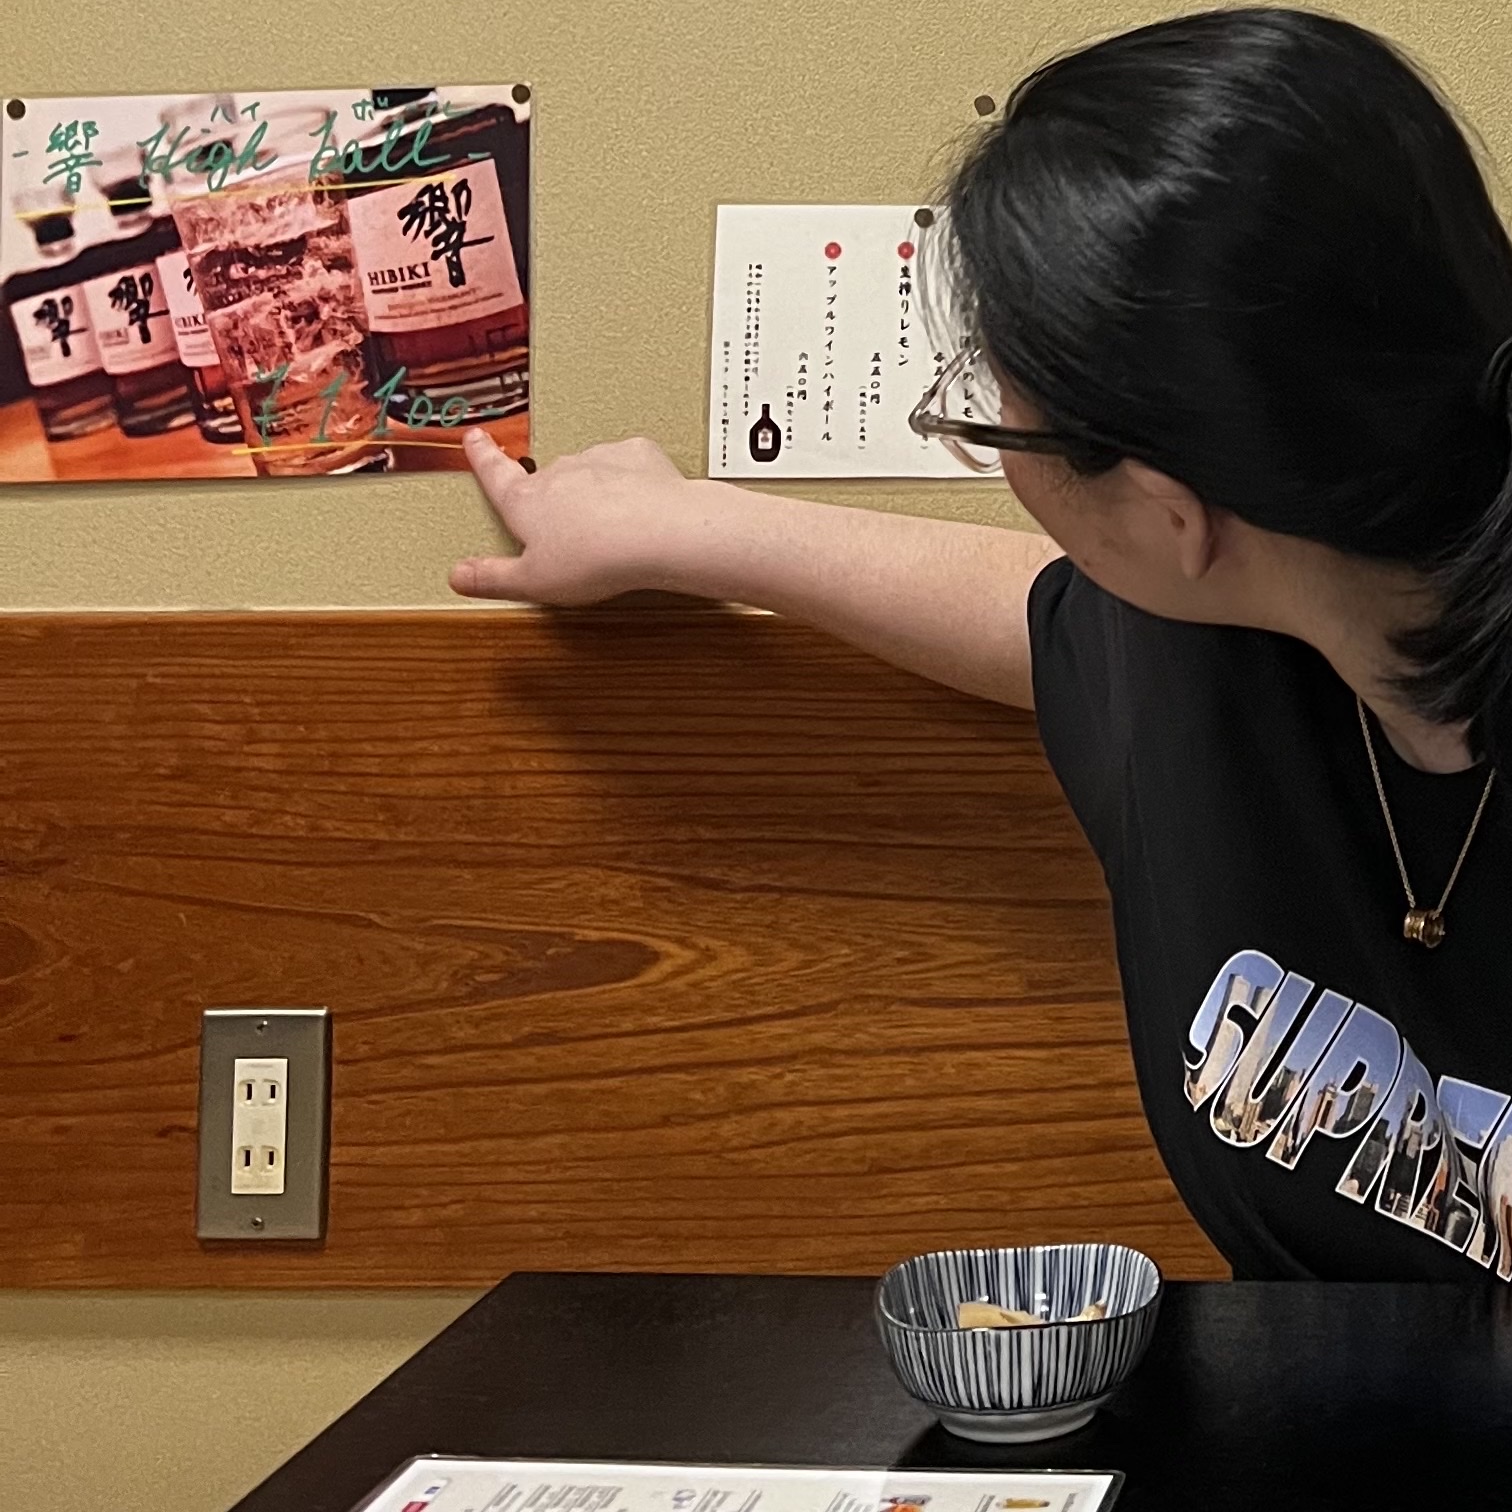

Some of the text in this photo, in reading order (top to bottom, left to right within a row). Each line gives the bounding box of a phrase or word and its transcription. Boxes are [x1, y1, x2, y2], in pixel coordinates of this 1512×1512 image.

[367, 262, 432, 287] HIBIKI
[821, 265, 837, 442] アップルワインハイボール
